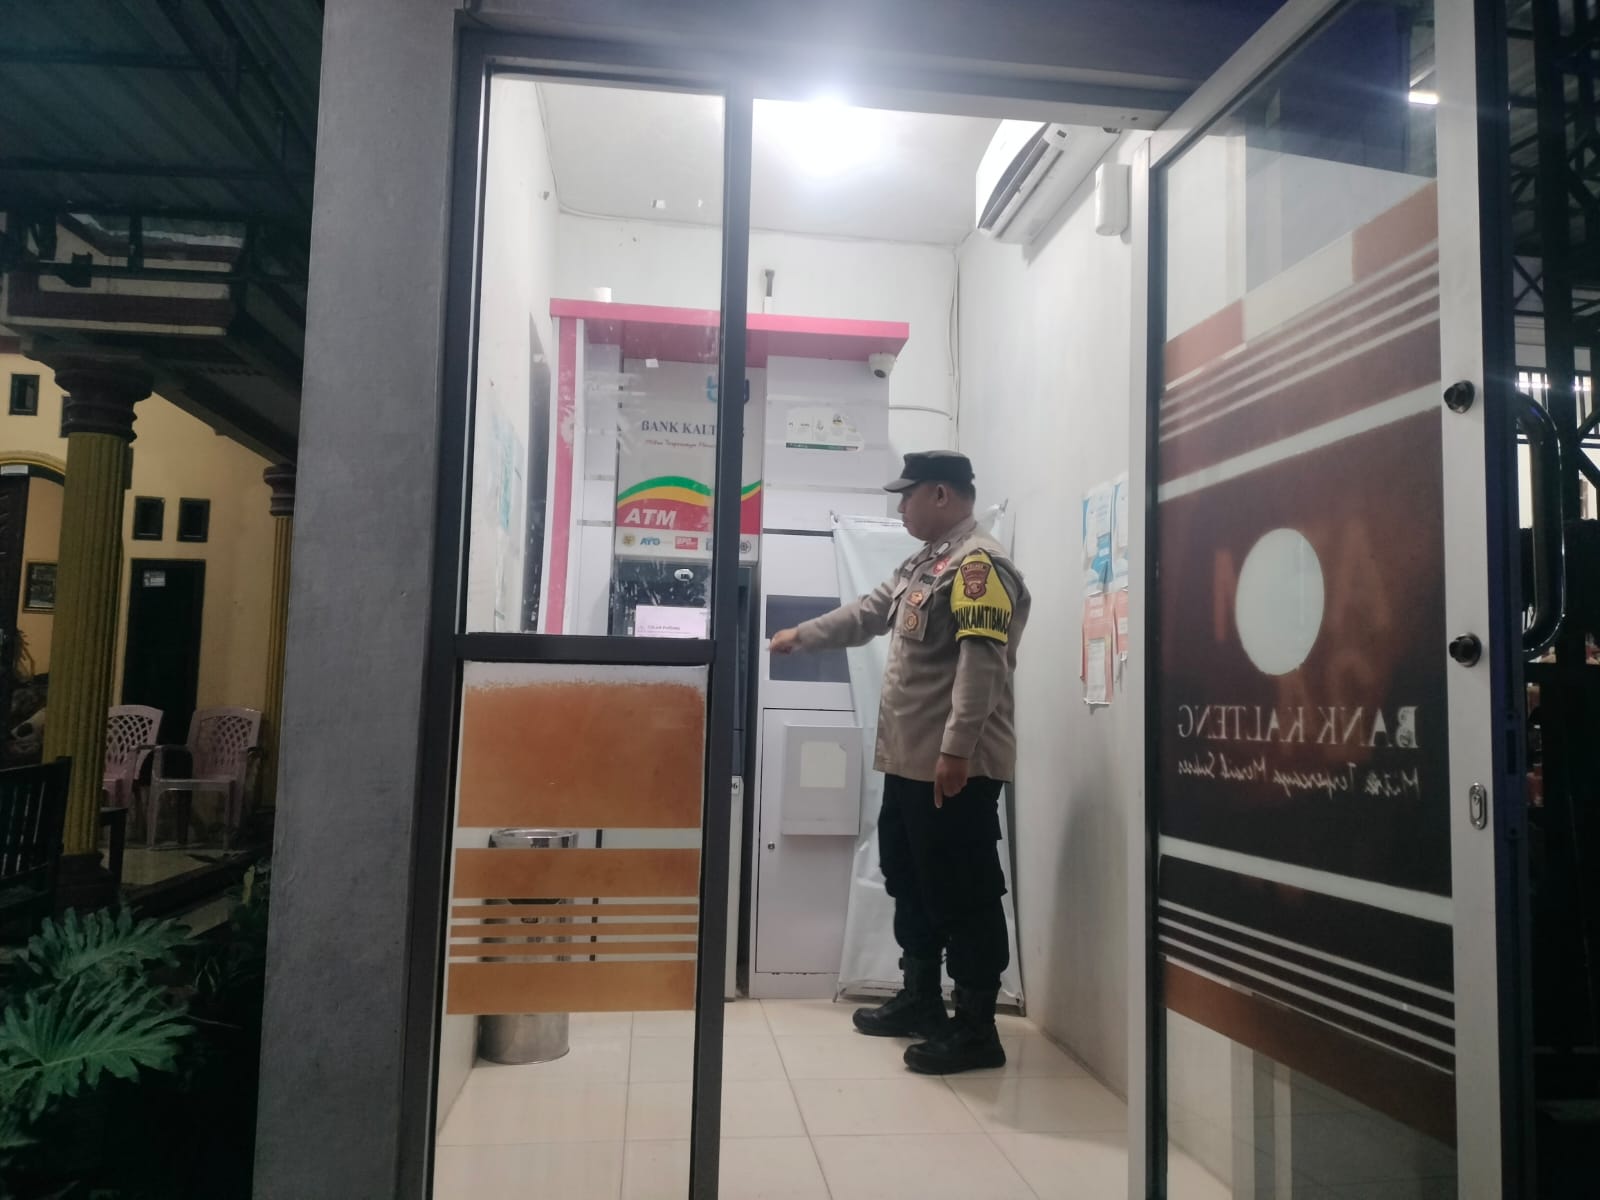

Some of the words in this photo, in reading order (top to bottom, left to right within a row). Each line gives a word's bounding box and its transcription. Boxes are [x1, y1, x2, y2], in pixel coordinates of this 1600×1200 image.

[641, 420, 678, 433] BANK
[681, 422, 715, 435] KALT
[624, 507, 677, 528] ATM
